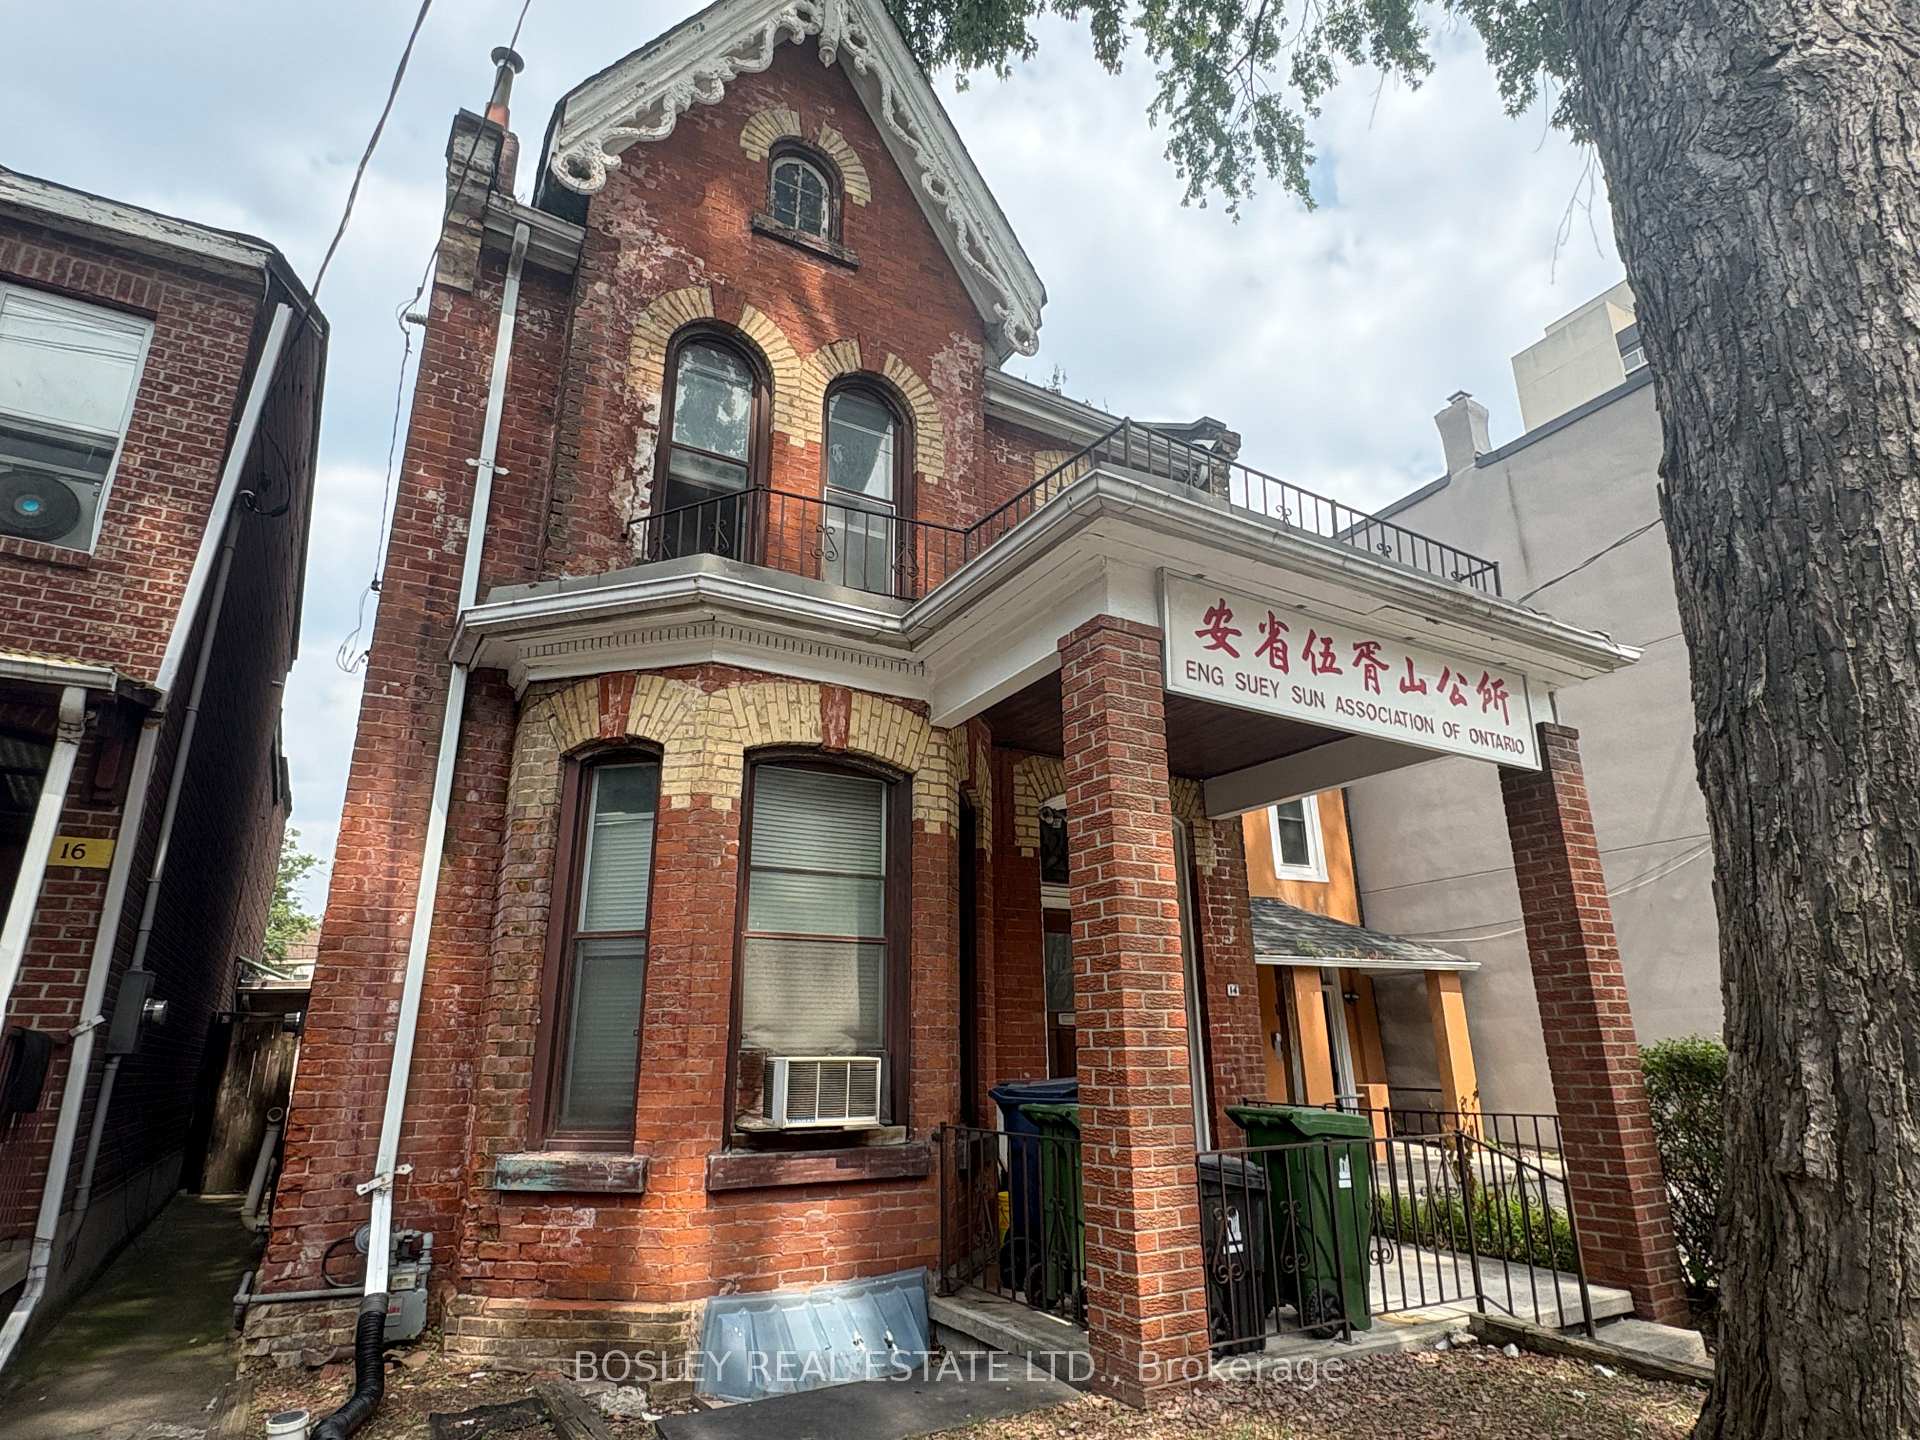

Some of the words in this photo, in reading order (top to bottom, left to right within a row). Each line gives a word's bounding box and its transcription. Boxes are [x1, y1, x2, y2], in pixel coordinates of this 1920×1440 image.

[1186, 660, 1224, 687] ENG
[1235, 672, 1280, 698] SUEY
[1292, 685, 1326, 709] SUN
[1335, 695, 1435, 734] ASSOCIATION
[1442, 721, 1461, 740] OF
[1469, 728, 1525, 755] ONTARIO
[60, 843, 86, 860] 16
